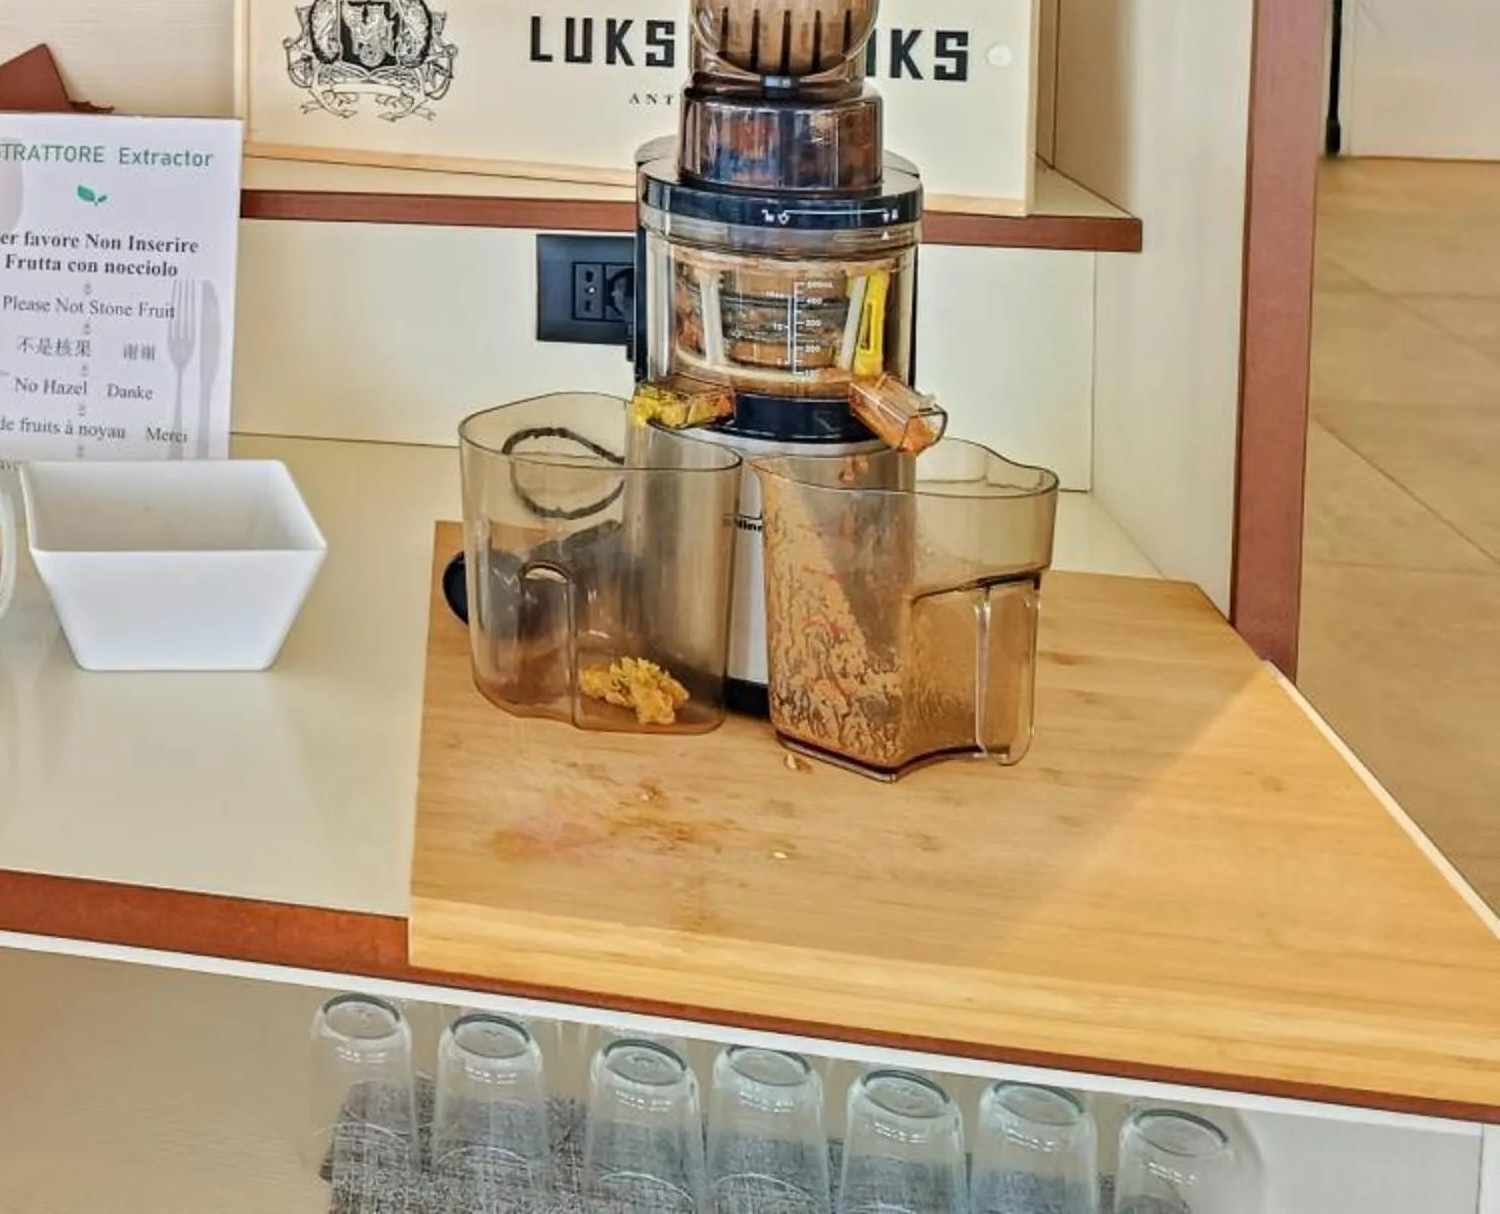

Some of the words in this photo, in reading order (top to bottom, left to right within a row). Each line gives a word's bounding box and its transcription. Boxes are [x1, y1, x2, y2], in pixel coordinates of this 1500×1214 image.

[531, 16, 675, 67] LUKS
[118, 147, 213, 167] Extractor
[24, 231, 79, 249] favore
[85, 234, 121, 251] Non
[128, 236, 199, 254] Inserire
[5, 254, 61, 272] Frutta
[67, 260, 99, 273] con
[104, 261, 178, 277] nocciolo
[2, 295, 50, 312] Please
[55, 297, 84, 314] Not
[89, 299, 132, 317] Stone
[138, 301, 176, 319] Fruit
[17, 336, 91, 357] 不是核果
[15, 377, 38, 393] No
[43, 378, 88, 396] Hazel
[107, 383, 154, 400] Danke
[19, 417, 61, 434] fruits
[78, 424, 125, 440] noyau
[145, 427, 188, 443] Merci
